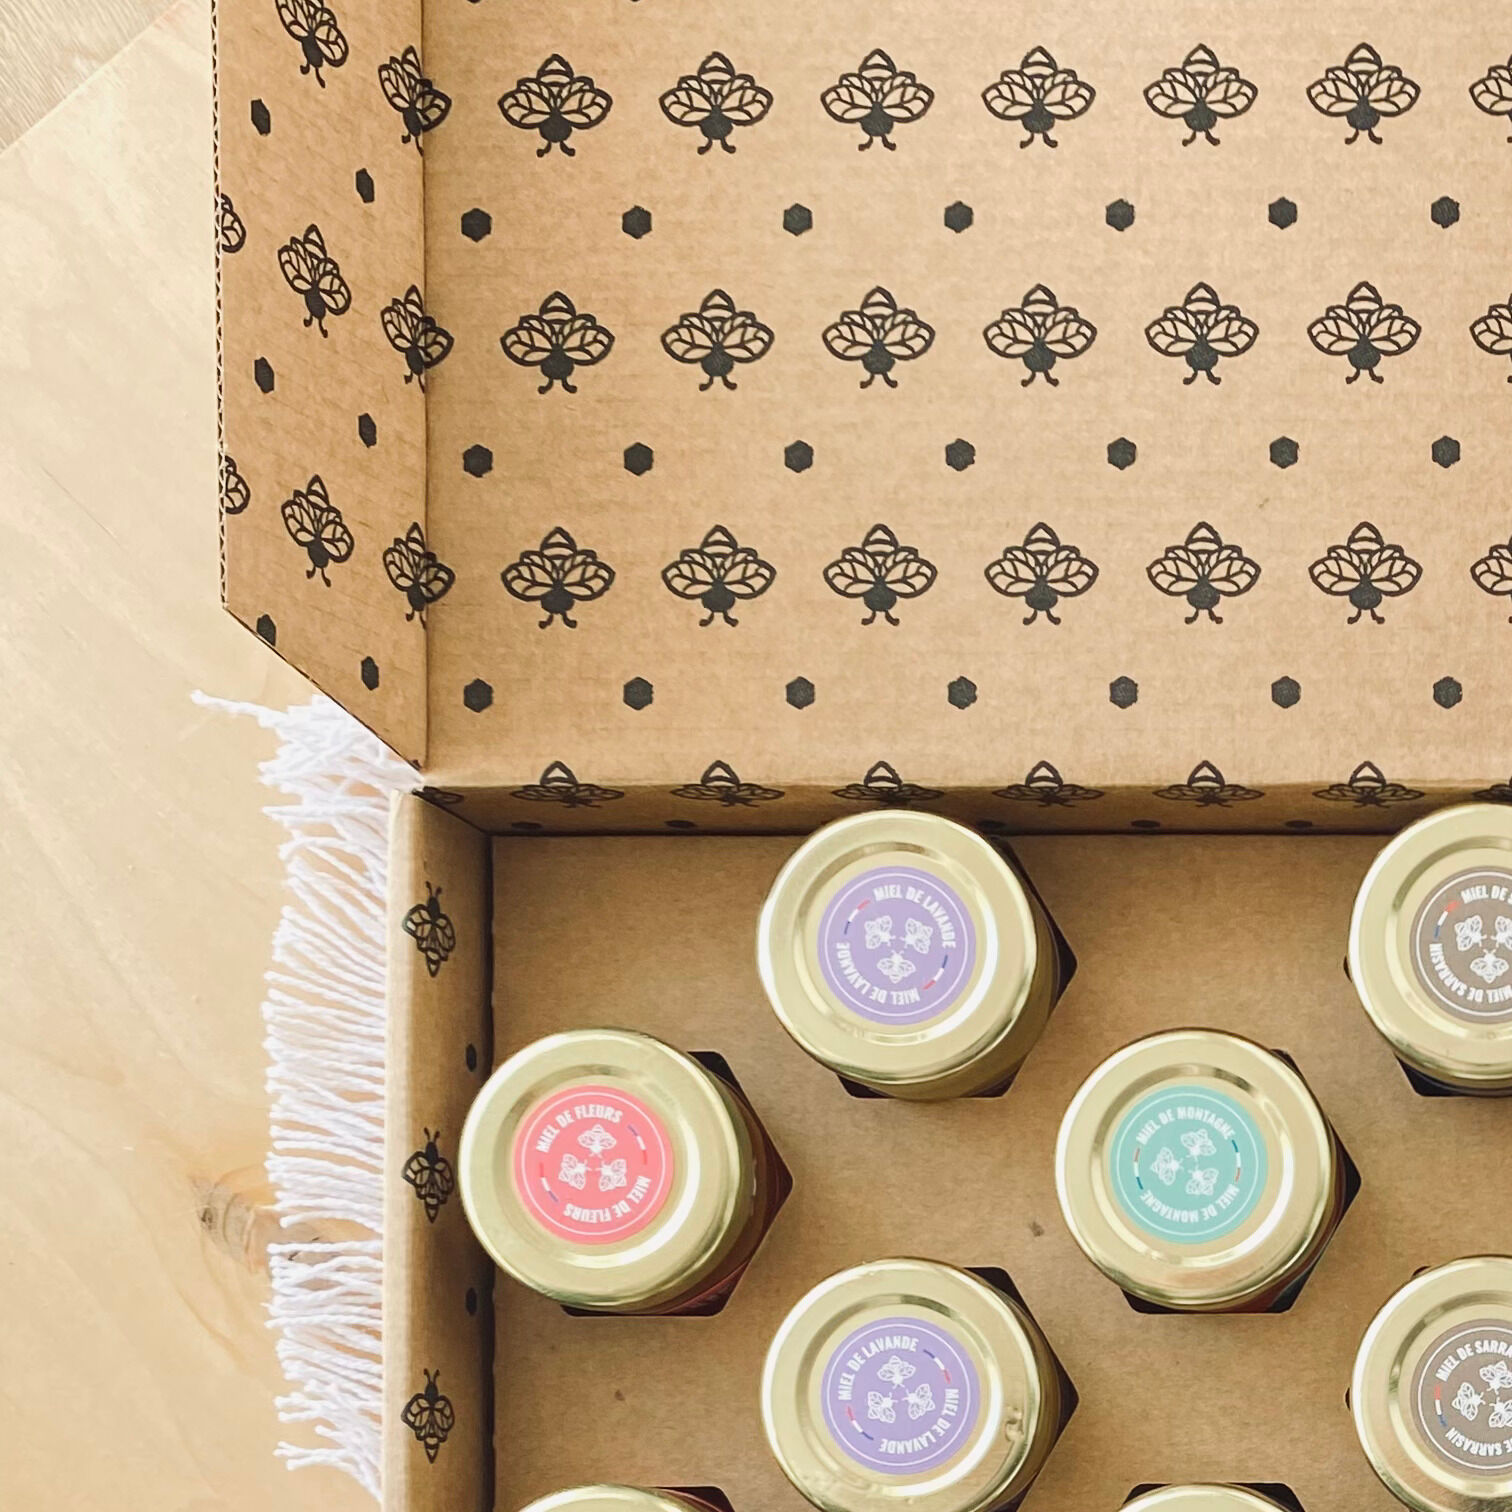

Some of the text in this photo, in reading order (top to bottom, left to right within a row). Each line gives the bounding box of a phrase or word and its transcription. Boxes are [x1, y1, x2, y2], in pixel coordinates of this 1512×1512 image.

[873, 885, 956, 948] MIEL DE LAVANDE
[1461, 886, 1488, 903] MIEL
[1491, 886, 1508, 900] DE
[837, 943, 920, 1005] MIEL DE LAVANDE
[1430, 944, 1512, 1003] MIEL DE SARRASIN
[536, 1104, 622, 1152] MIEL DE FLEURS
[1136, 1107, 1235, 1144] MIEL DE MONTAGNE
[564, 1176, 651, 1223] MIEL DE FLEURS
[1140, 1184, 1239, 1222] MIEL DE MONTAGNE
[838, 1336, 918, 1400] MIEL DE LAVANDE
[1436, 1356, 1460, 1381] MIEL
[1457, 1344, 1474, 1360] DE
[879, 1389, 959, 1454] MIEL DE LAVANDE
[1446, 1428, 1502, 1456] SARRASIN
